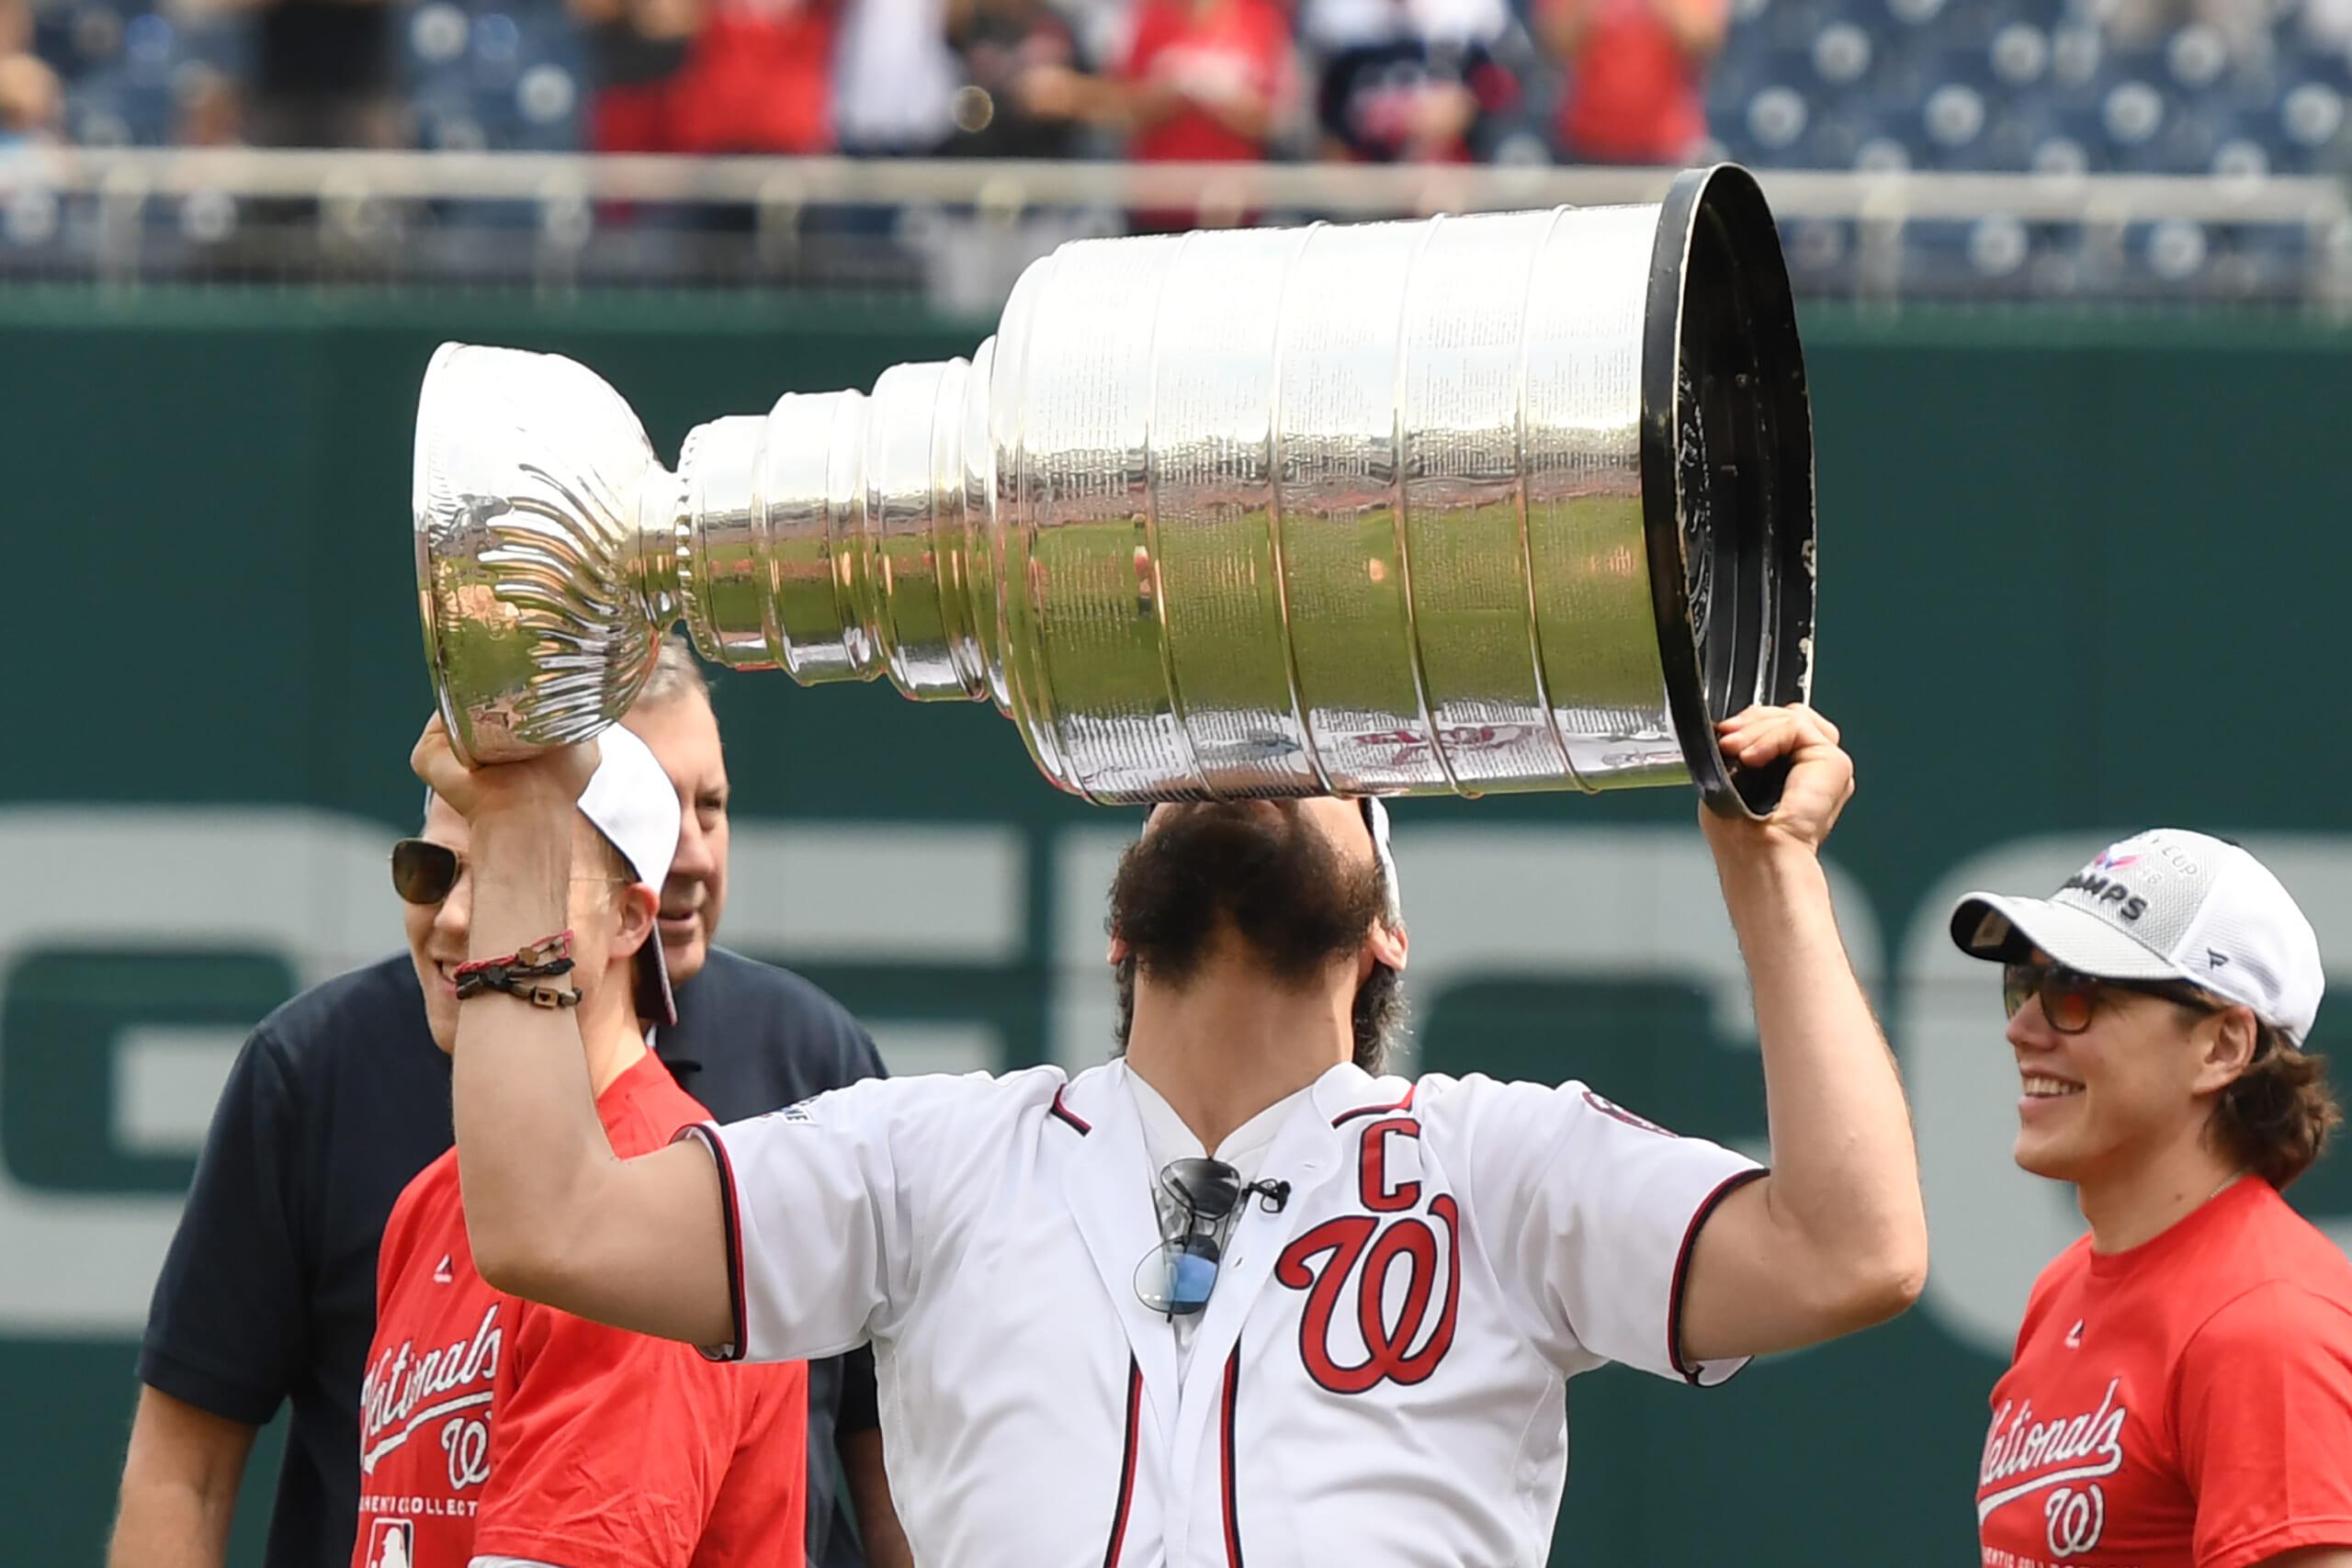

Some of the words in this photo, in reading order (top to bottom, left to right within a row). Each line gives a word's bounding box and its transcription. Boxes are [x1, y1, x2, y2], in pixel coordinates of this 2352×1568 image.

[2061, 873, 2148, 921] AMPS
[2161, 844, 2199, 876] CUP
[1359, 1117, 1421, 1213] C
[1275, 1193, 1460, 1394] W
[360, 1301, 503, 1438] Natinals
[441, 1410, 492, 1491] W
[2044, 1482, 2104, 1559] W
